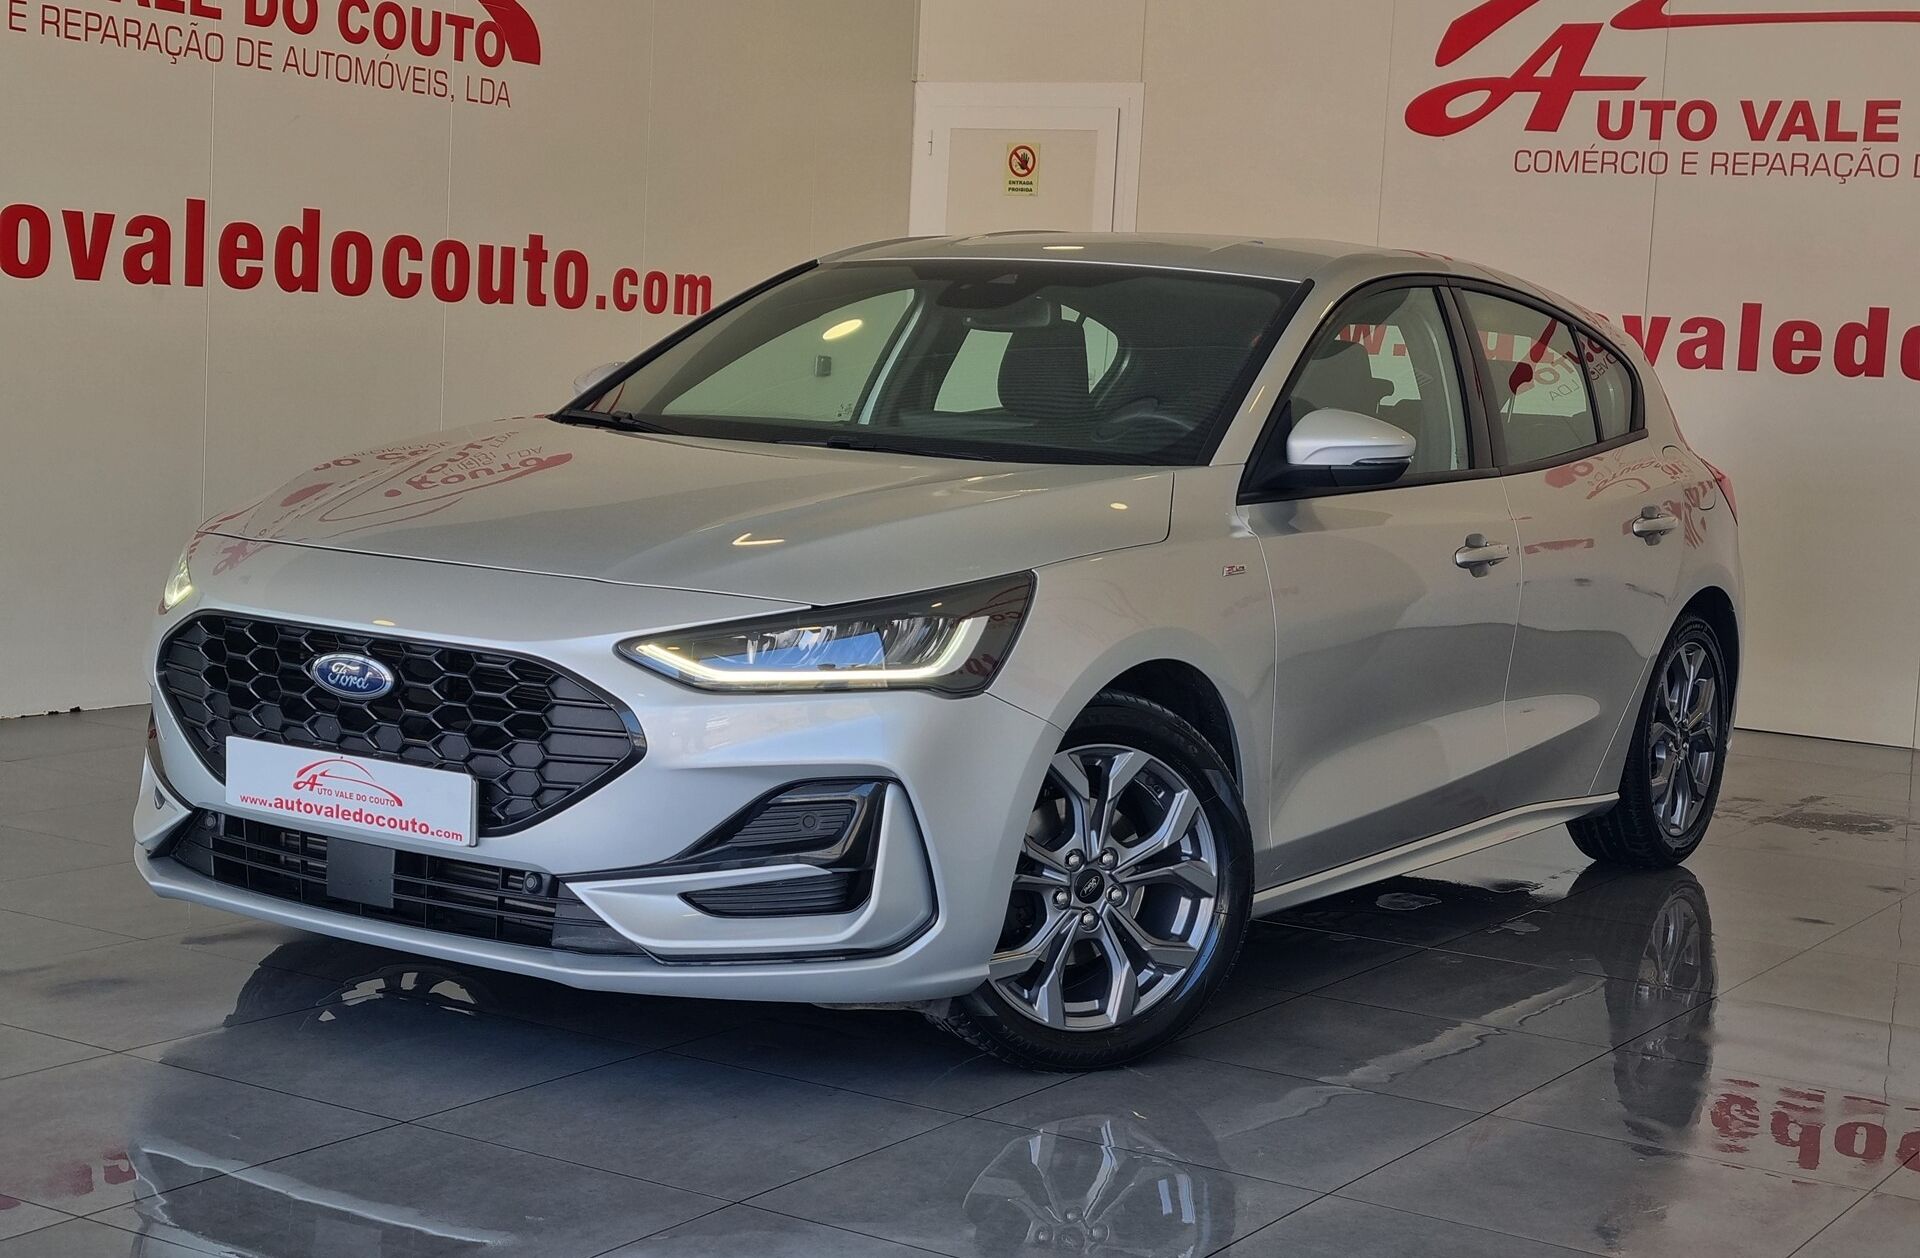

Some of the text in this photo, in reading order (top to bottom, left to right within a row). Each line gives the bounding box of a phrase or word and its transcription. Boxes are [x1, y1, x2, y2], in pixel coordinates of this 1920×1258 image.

[8, 0, 28, 33] E
[41, 4, 225, 65] REPARAÇÃO
[236, 36, 273, 71] DE
[282, 46, 455, 103] AUTOMÓVEIS,
[466, 75, 512, 108] LDA
[337, 0, 506, 68] COUTO
[1740, 100, 1902, 142] VALE
[1513, 144, 1669, 175] COMÉRCIO
[1681, 151, 1699, 175] E
[1710, 147, 1901, 185] REPARAÇÃO
[327, 661, 374, 691] Ford
[239, 794, 463, 842] www.autovaledocouto.com
[335, 790, 354, 800] VALE
[356, 793, 367, 802] DO
[369, 795, 396, 807] COUTO
